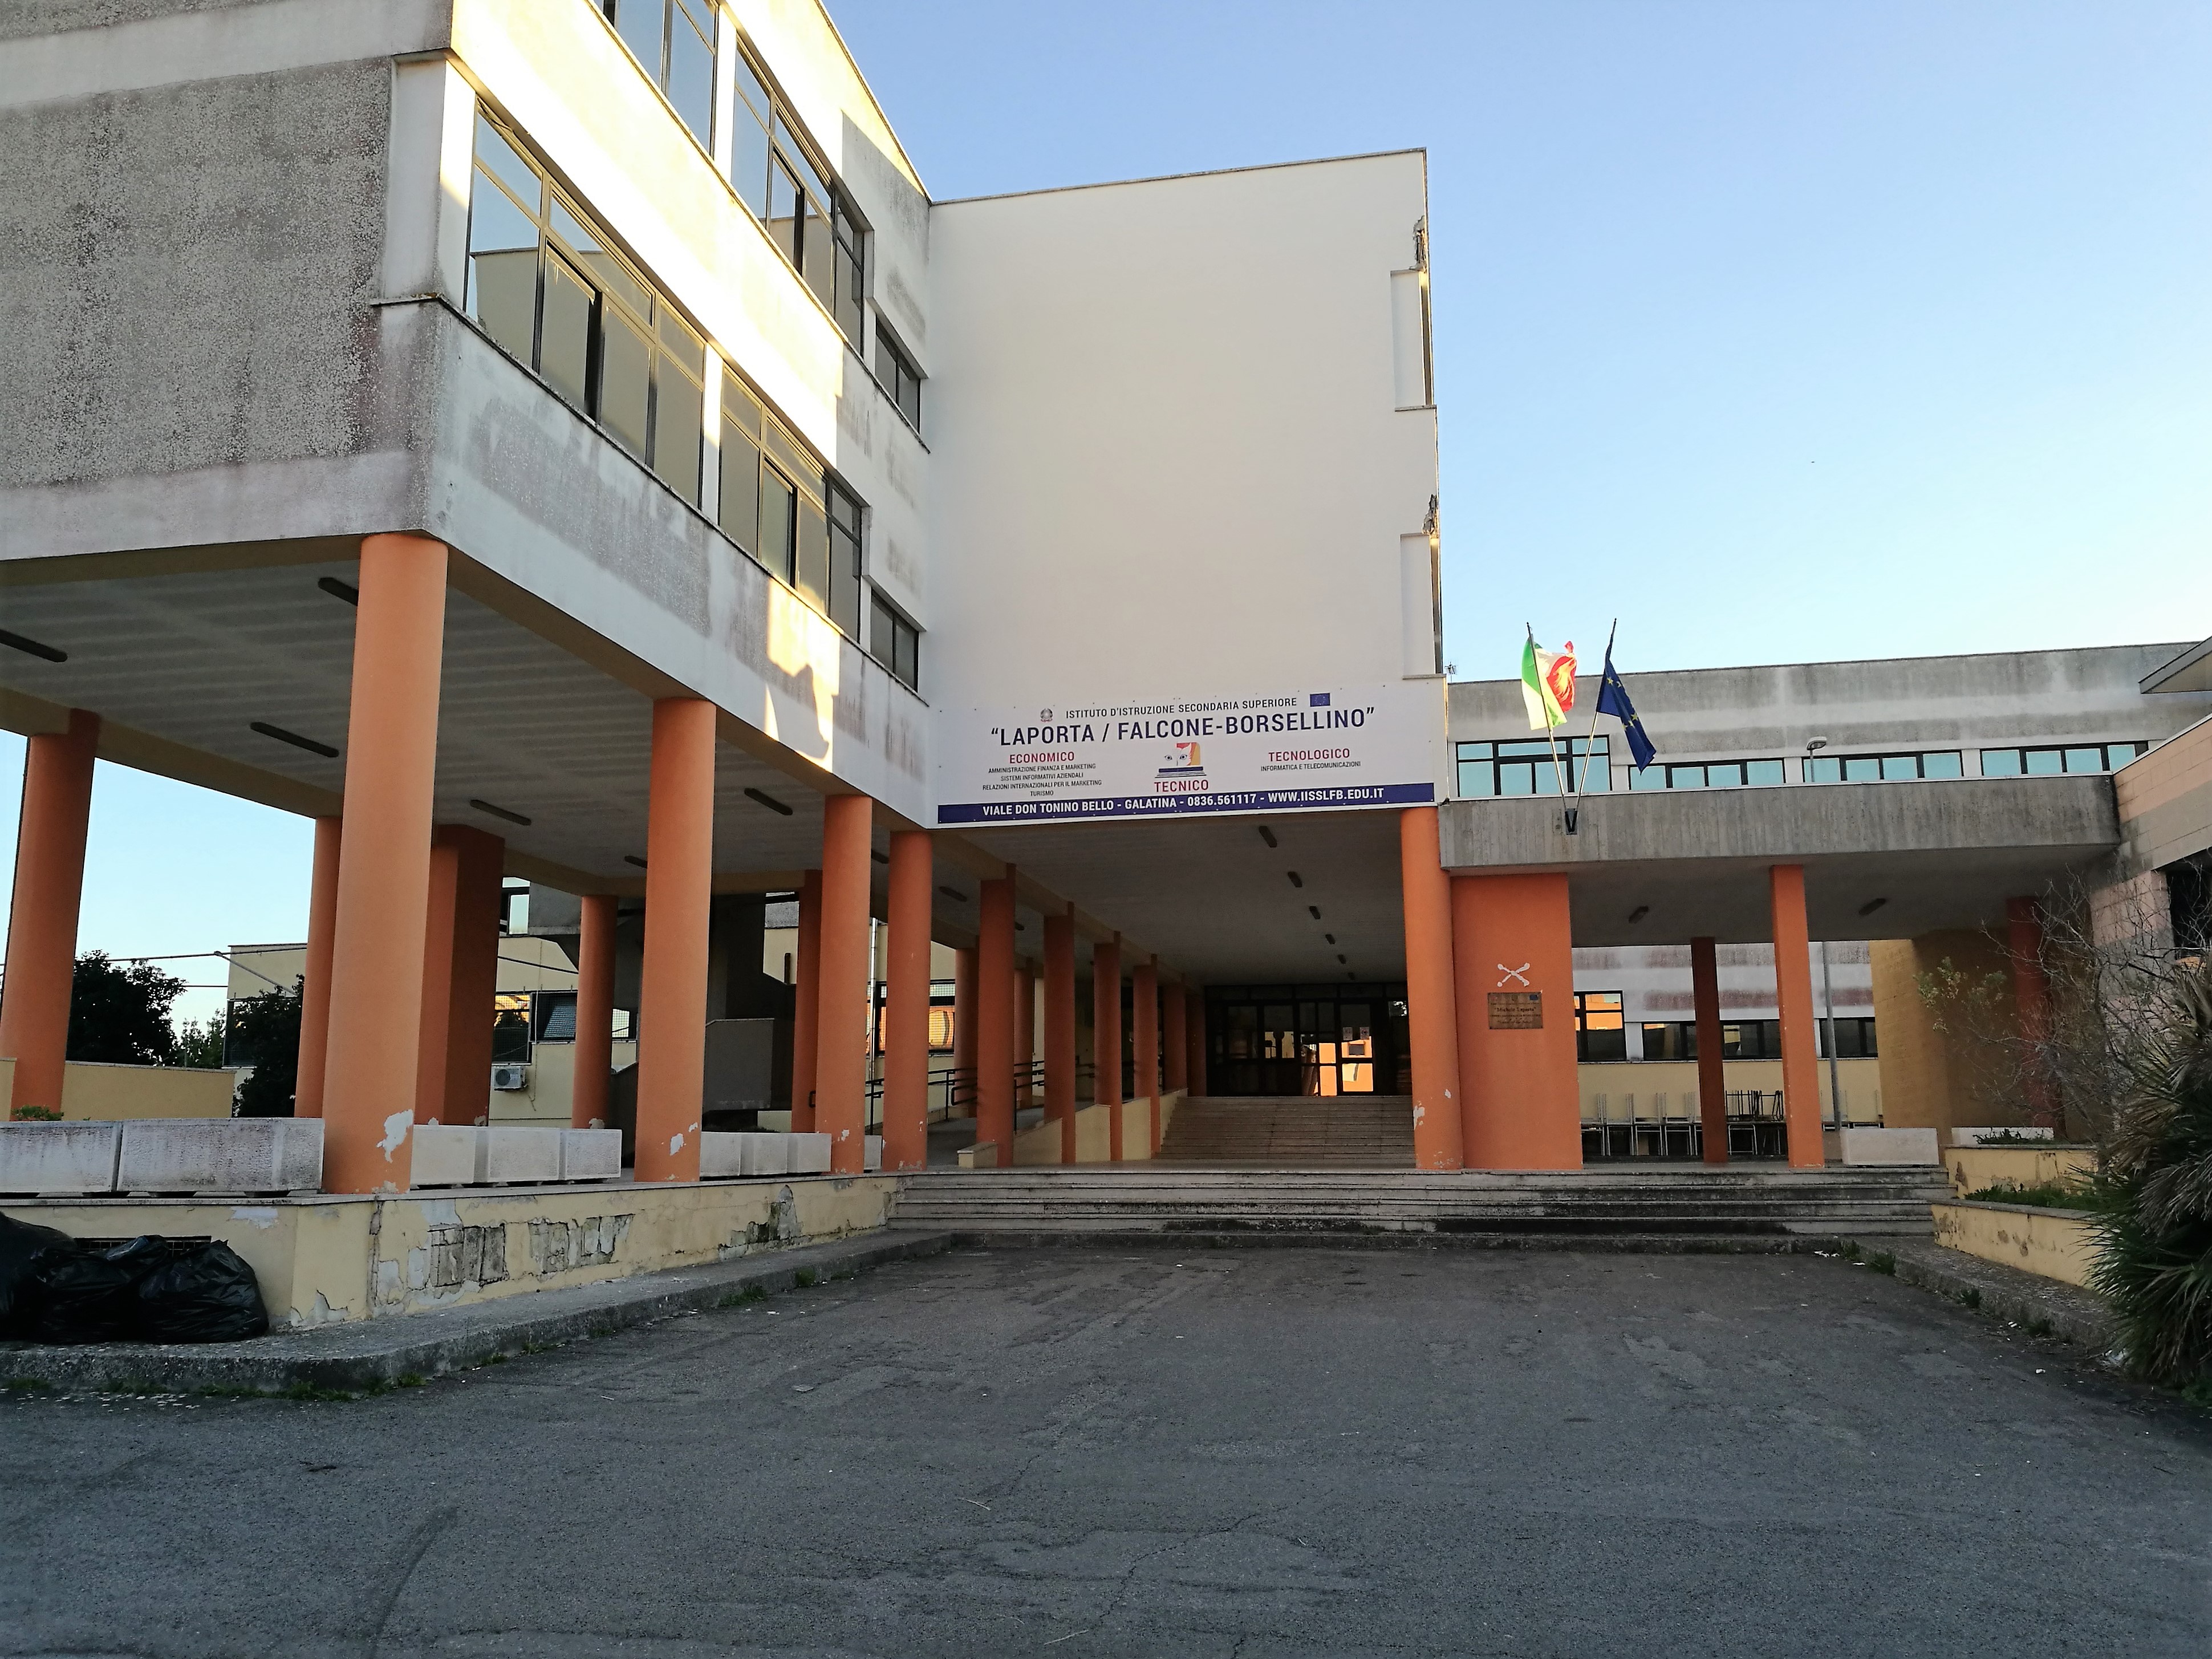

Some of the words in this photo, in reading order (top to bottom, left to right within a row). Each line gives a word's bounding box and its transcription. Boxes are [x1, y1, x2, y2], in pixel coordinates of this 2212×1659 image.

[1066, 708, 1107, 719] ISTITUTO
[1111, 705, 1174, 716] D'ISTRUZIONE
[1178, 701, 1239, 713] SECONDARIA
[1243, 697, 1297, 709] SUPERIORE
[1102, 723, 1109, 742] /
[1009, 751, 1074, 764] ECONOMICO
[1268, 748, 1350, 762] TECNOLOGICO
[1304, 761, 1361, 769] TELECOMUNICAZIONI
[1154, 779, 1209, 792] TECNICO
[983, 805, 1012, 816] VIALE
[1015, 804, 1037, 814] DON
[1040, 802, 1079, 813] TONINO
[1082, 800, 1114, 812] BELLO
[1125, 797, 1177, 809] GALATINA
[1187, 793, 1257, 806] 0836.561117
[1268, 788, 1385, 803] WWW.IISSLFB.EDU.IT
